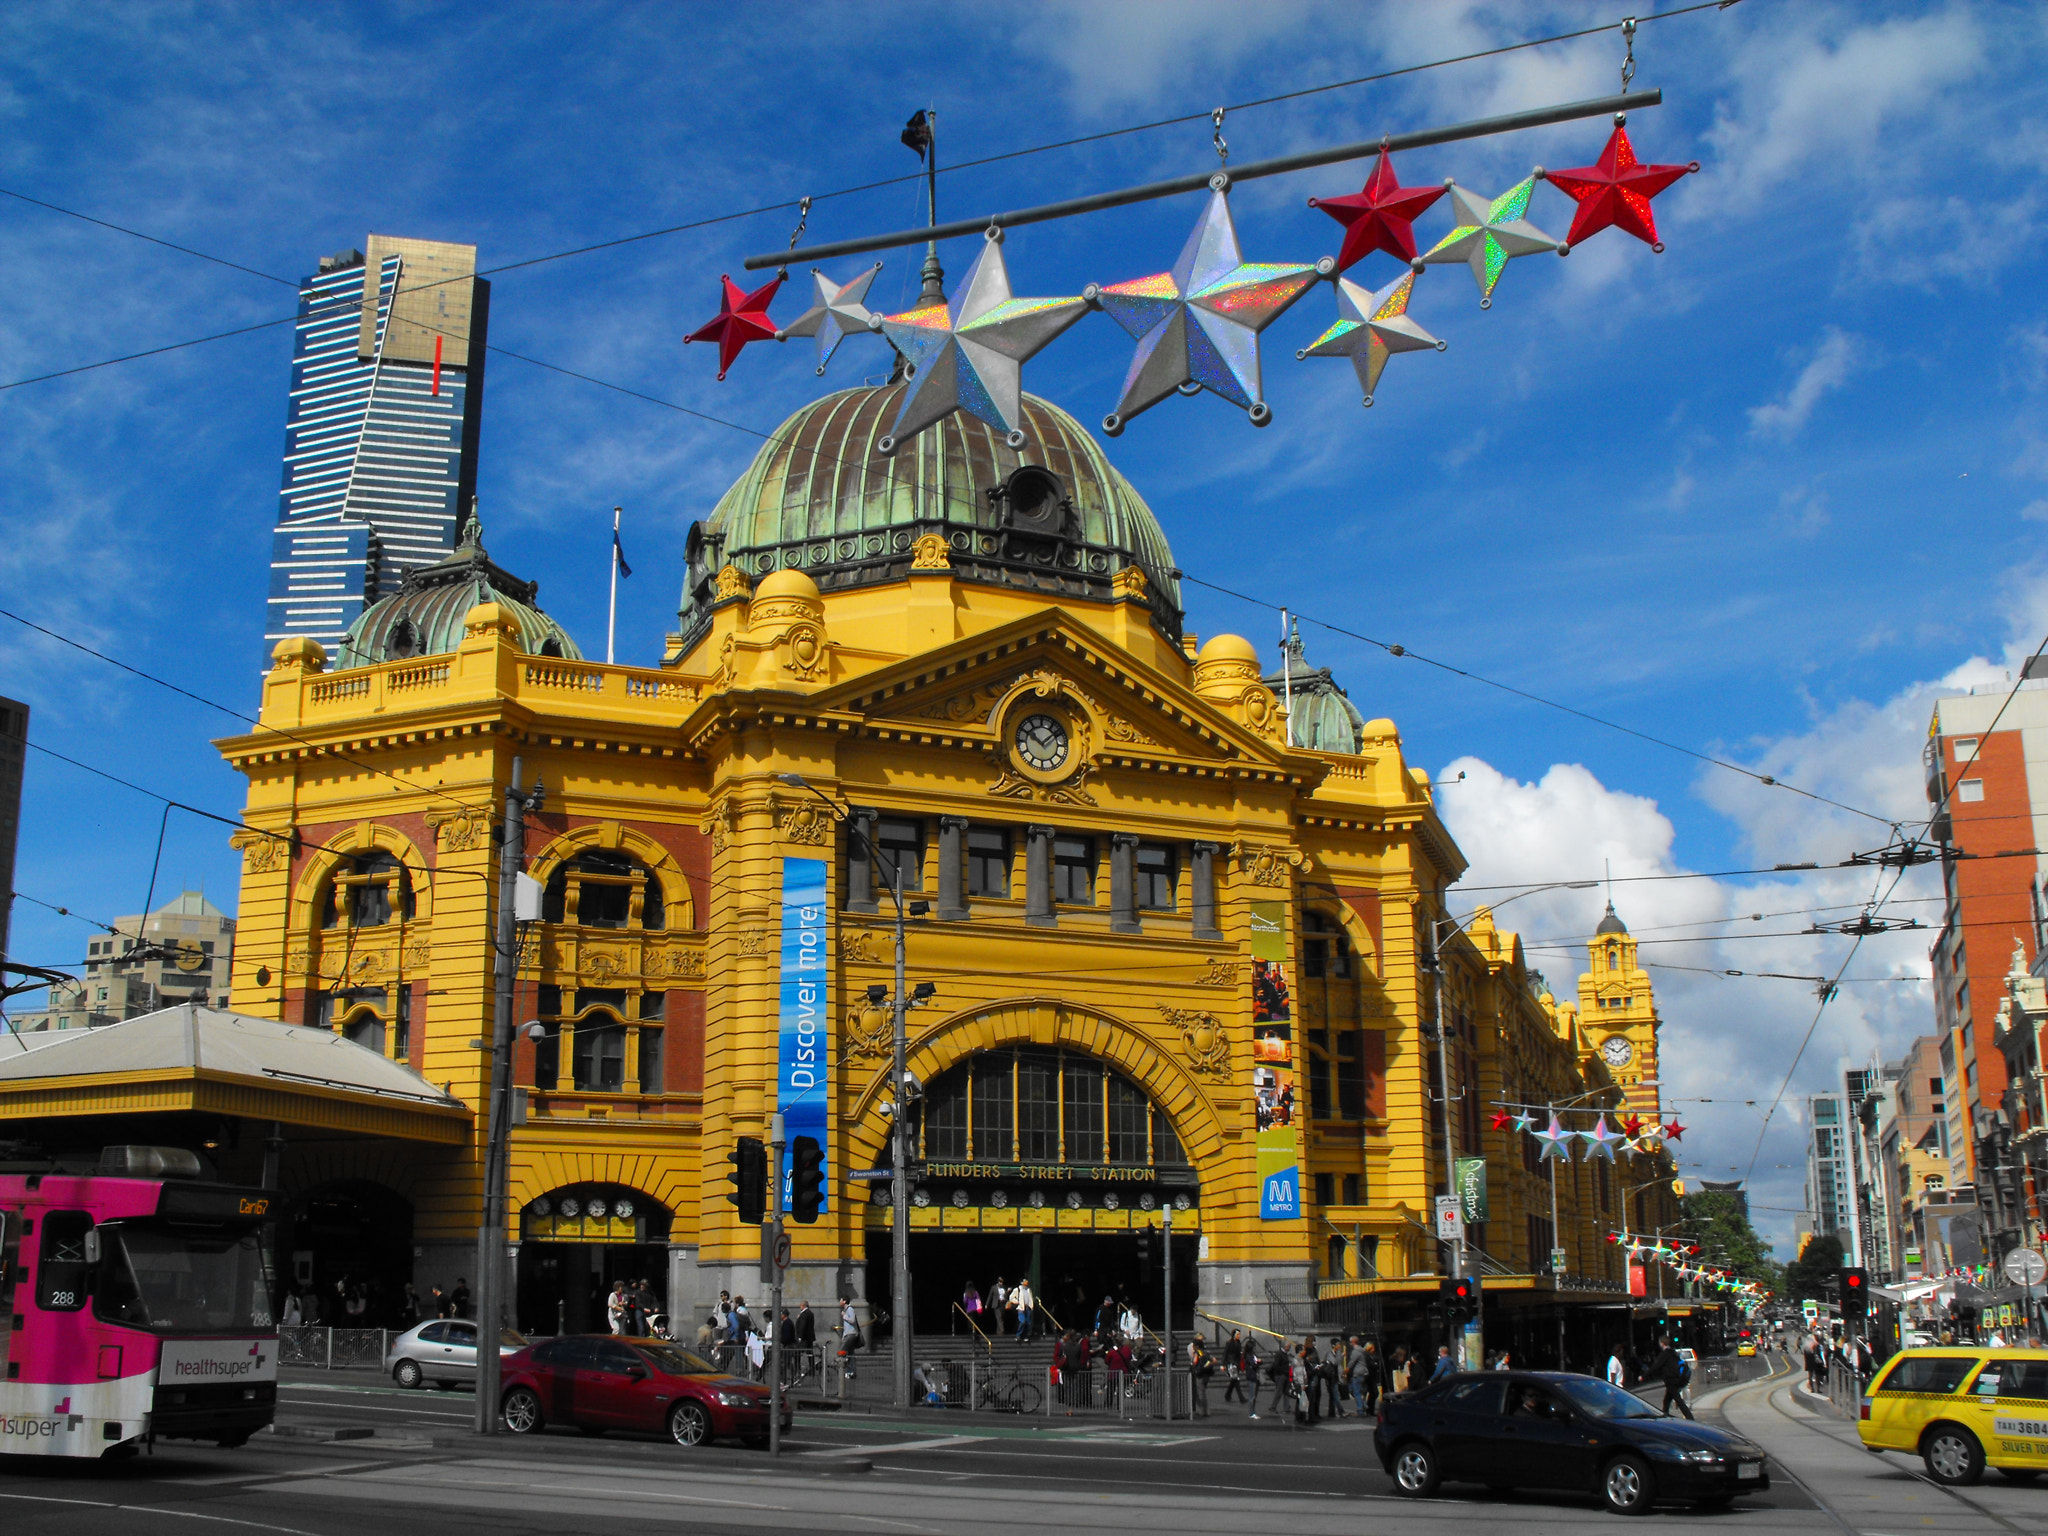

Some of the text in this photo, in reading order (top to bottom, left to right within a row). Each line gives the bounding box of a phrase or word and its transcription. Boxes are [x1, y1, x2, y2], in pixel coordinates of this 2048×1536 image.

[790, 905, 818, 1089] Discover more
[926, 1163, 1156, 1181] FLINDERS STREET STATION
[52, 1291, 74, 1305] 288
[251, 1312, 272, 1327] 288
[175, 1358, 252, 1377] healthsuper
[1997, 1421, 2048, 1435] TAXI 3604
[2002, 1441, 2032, 1453] SILVER
